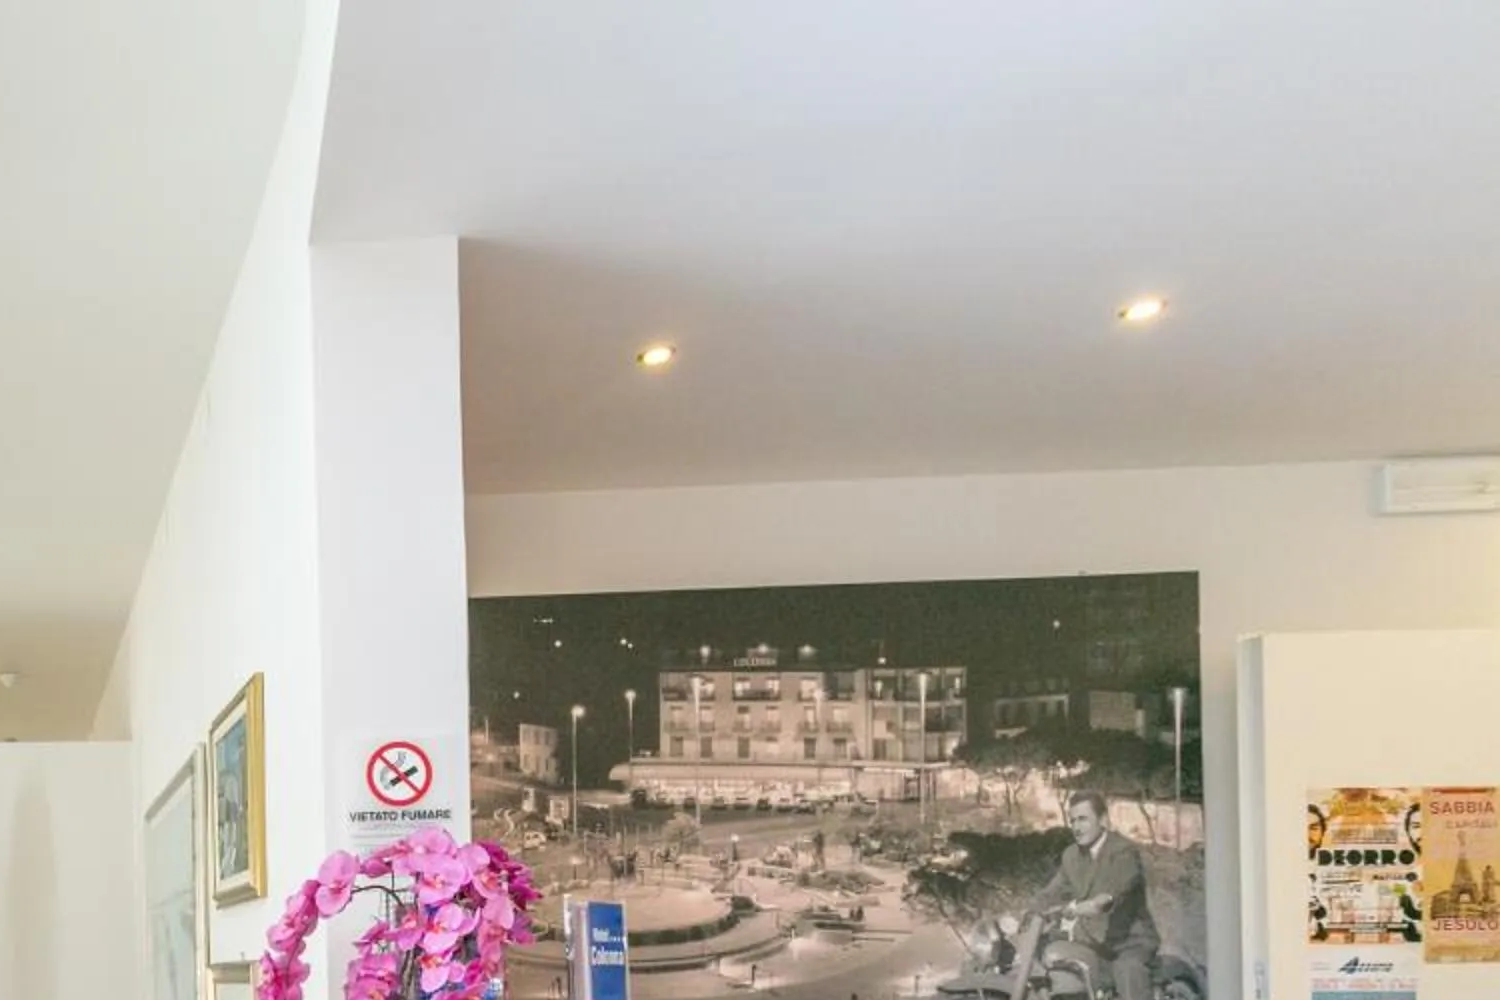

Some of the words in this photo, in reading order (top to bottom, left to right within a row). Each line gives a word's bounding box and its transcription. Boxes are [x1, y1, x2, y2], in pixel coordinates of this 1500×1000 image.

[1429, 801, 1495, 815] SABBIA
[349, 811, 398, 823] VIETATO
[401, 809, 452, 821] FUMARE
[1432, 918, 1499, 931] JESOLO
